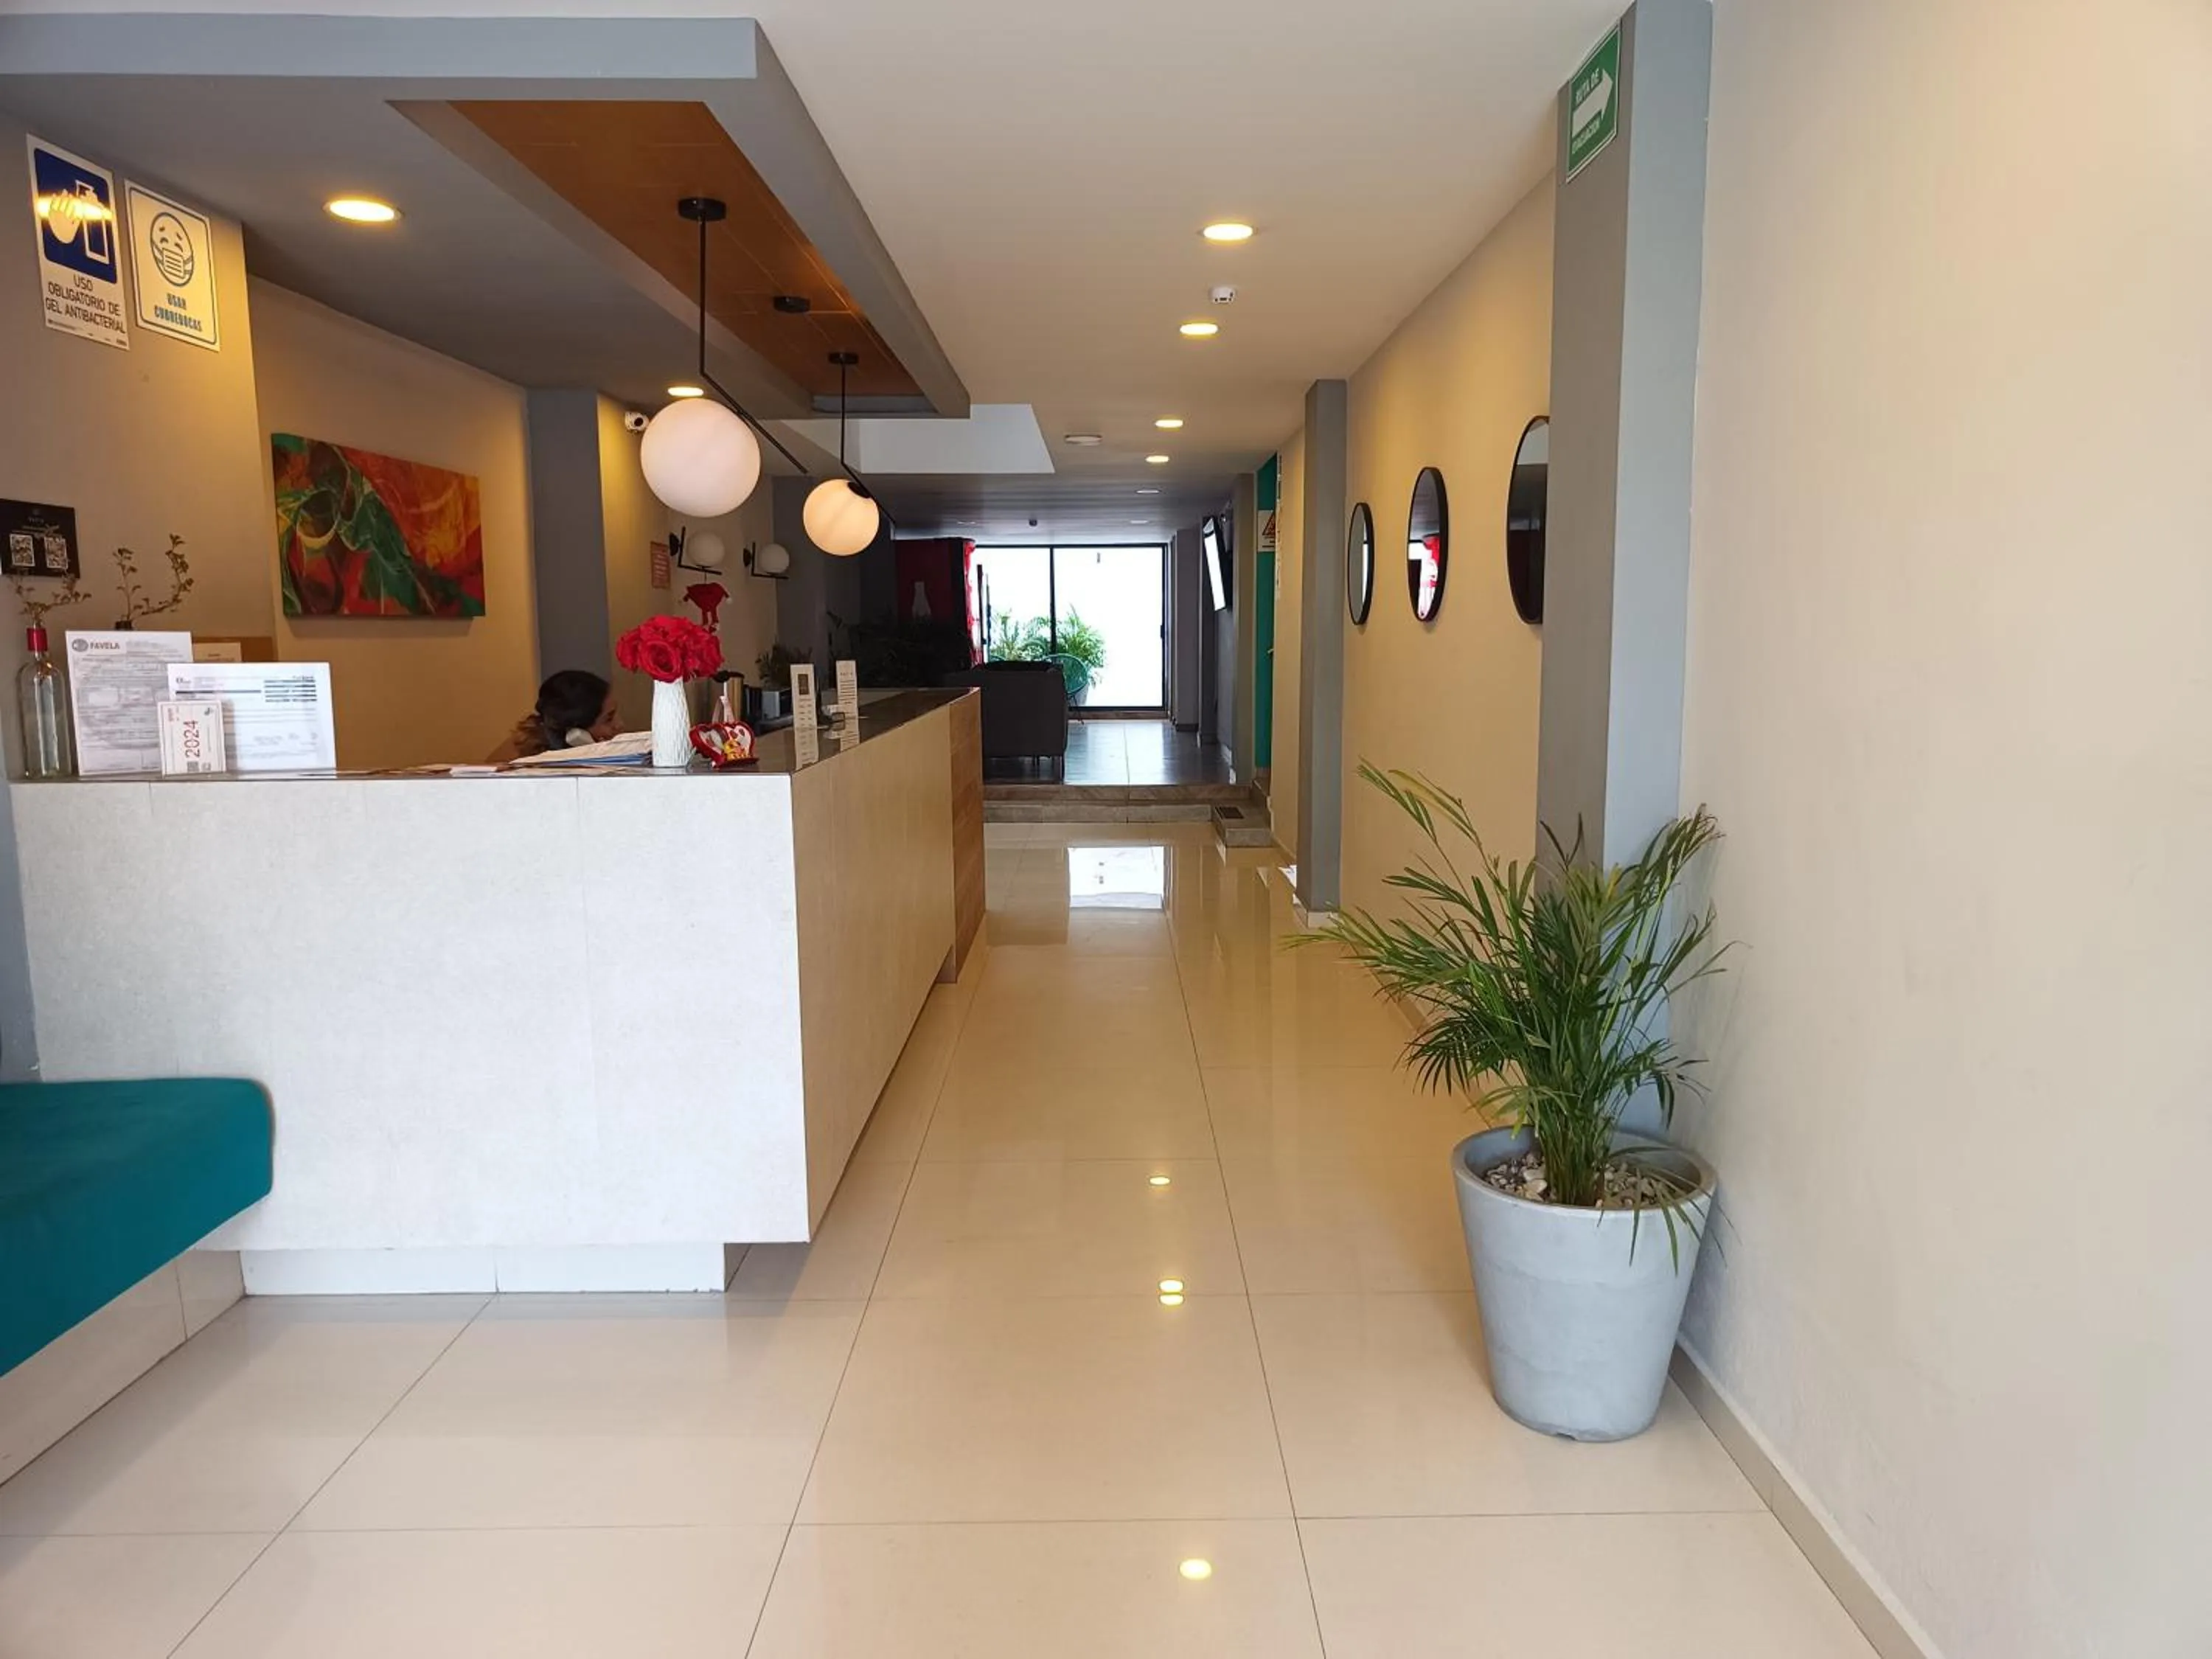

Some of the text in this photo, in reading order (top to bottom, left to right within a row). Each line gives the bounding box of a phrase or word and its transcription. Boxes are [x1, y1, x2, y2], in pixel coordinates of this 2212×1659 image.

[48, 281, 121, 316] OBLIGATORIO DE
[74, 274, 94, 292] USO
[45, 297, 63, 315] GEL
[65, 303, 126, 334] ANTIBACTERIAL
[89, 641, 121, 650] FAVELA
[183, 720, 201, 758] 2024
